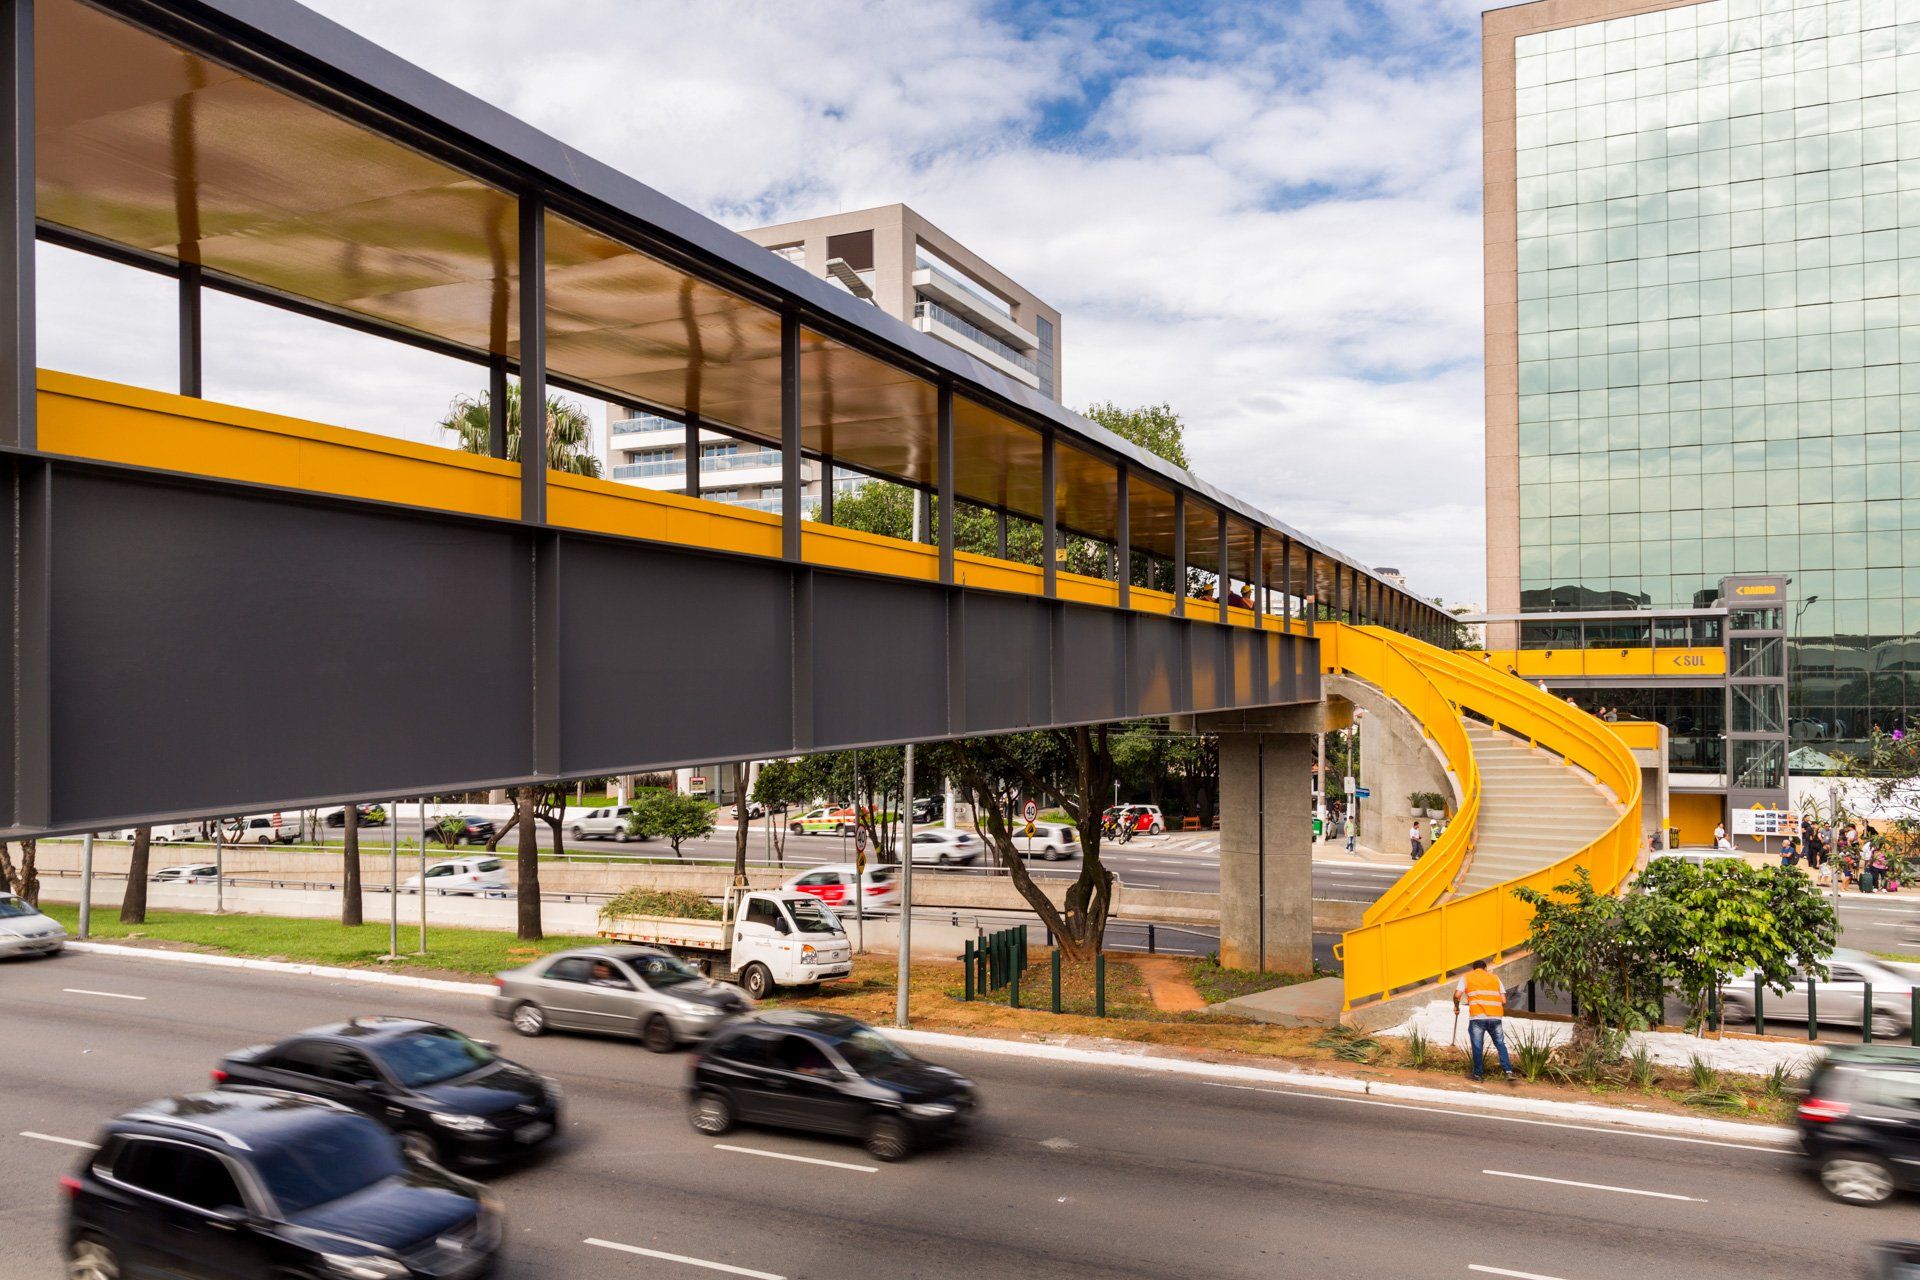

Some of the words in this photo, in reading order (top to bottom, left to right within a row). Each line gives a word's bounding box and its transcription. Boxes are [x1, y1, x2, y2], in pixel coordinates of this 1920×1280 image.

[1683, 655, 1705, 666] SUL
[1026, 806, 1035, 816] 40
[857, 831, 866, 844] 40
